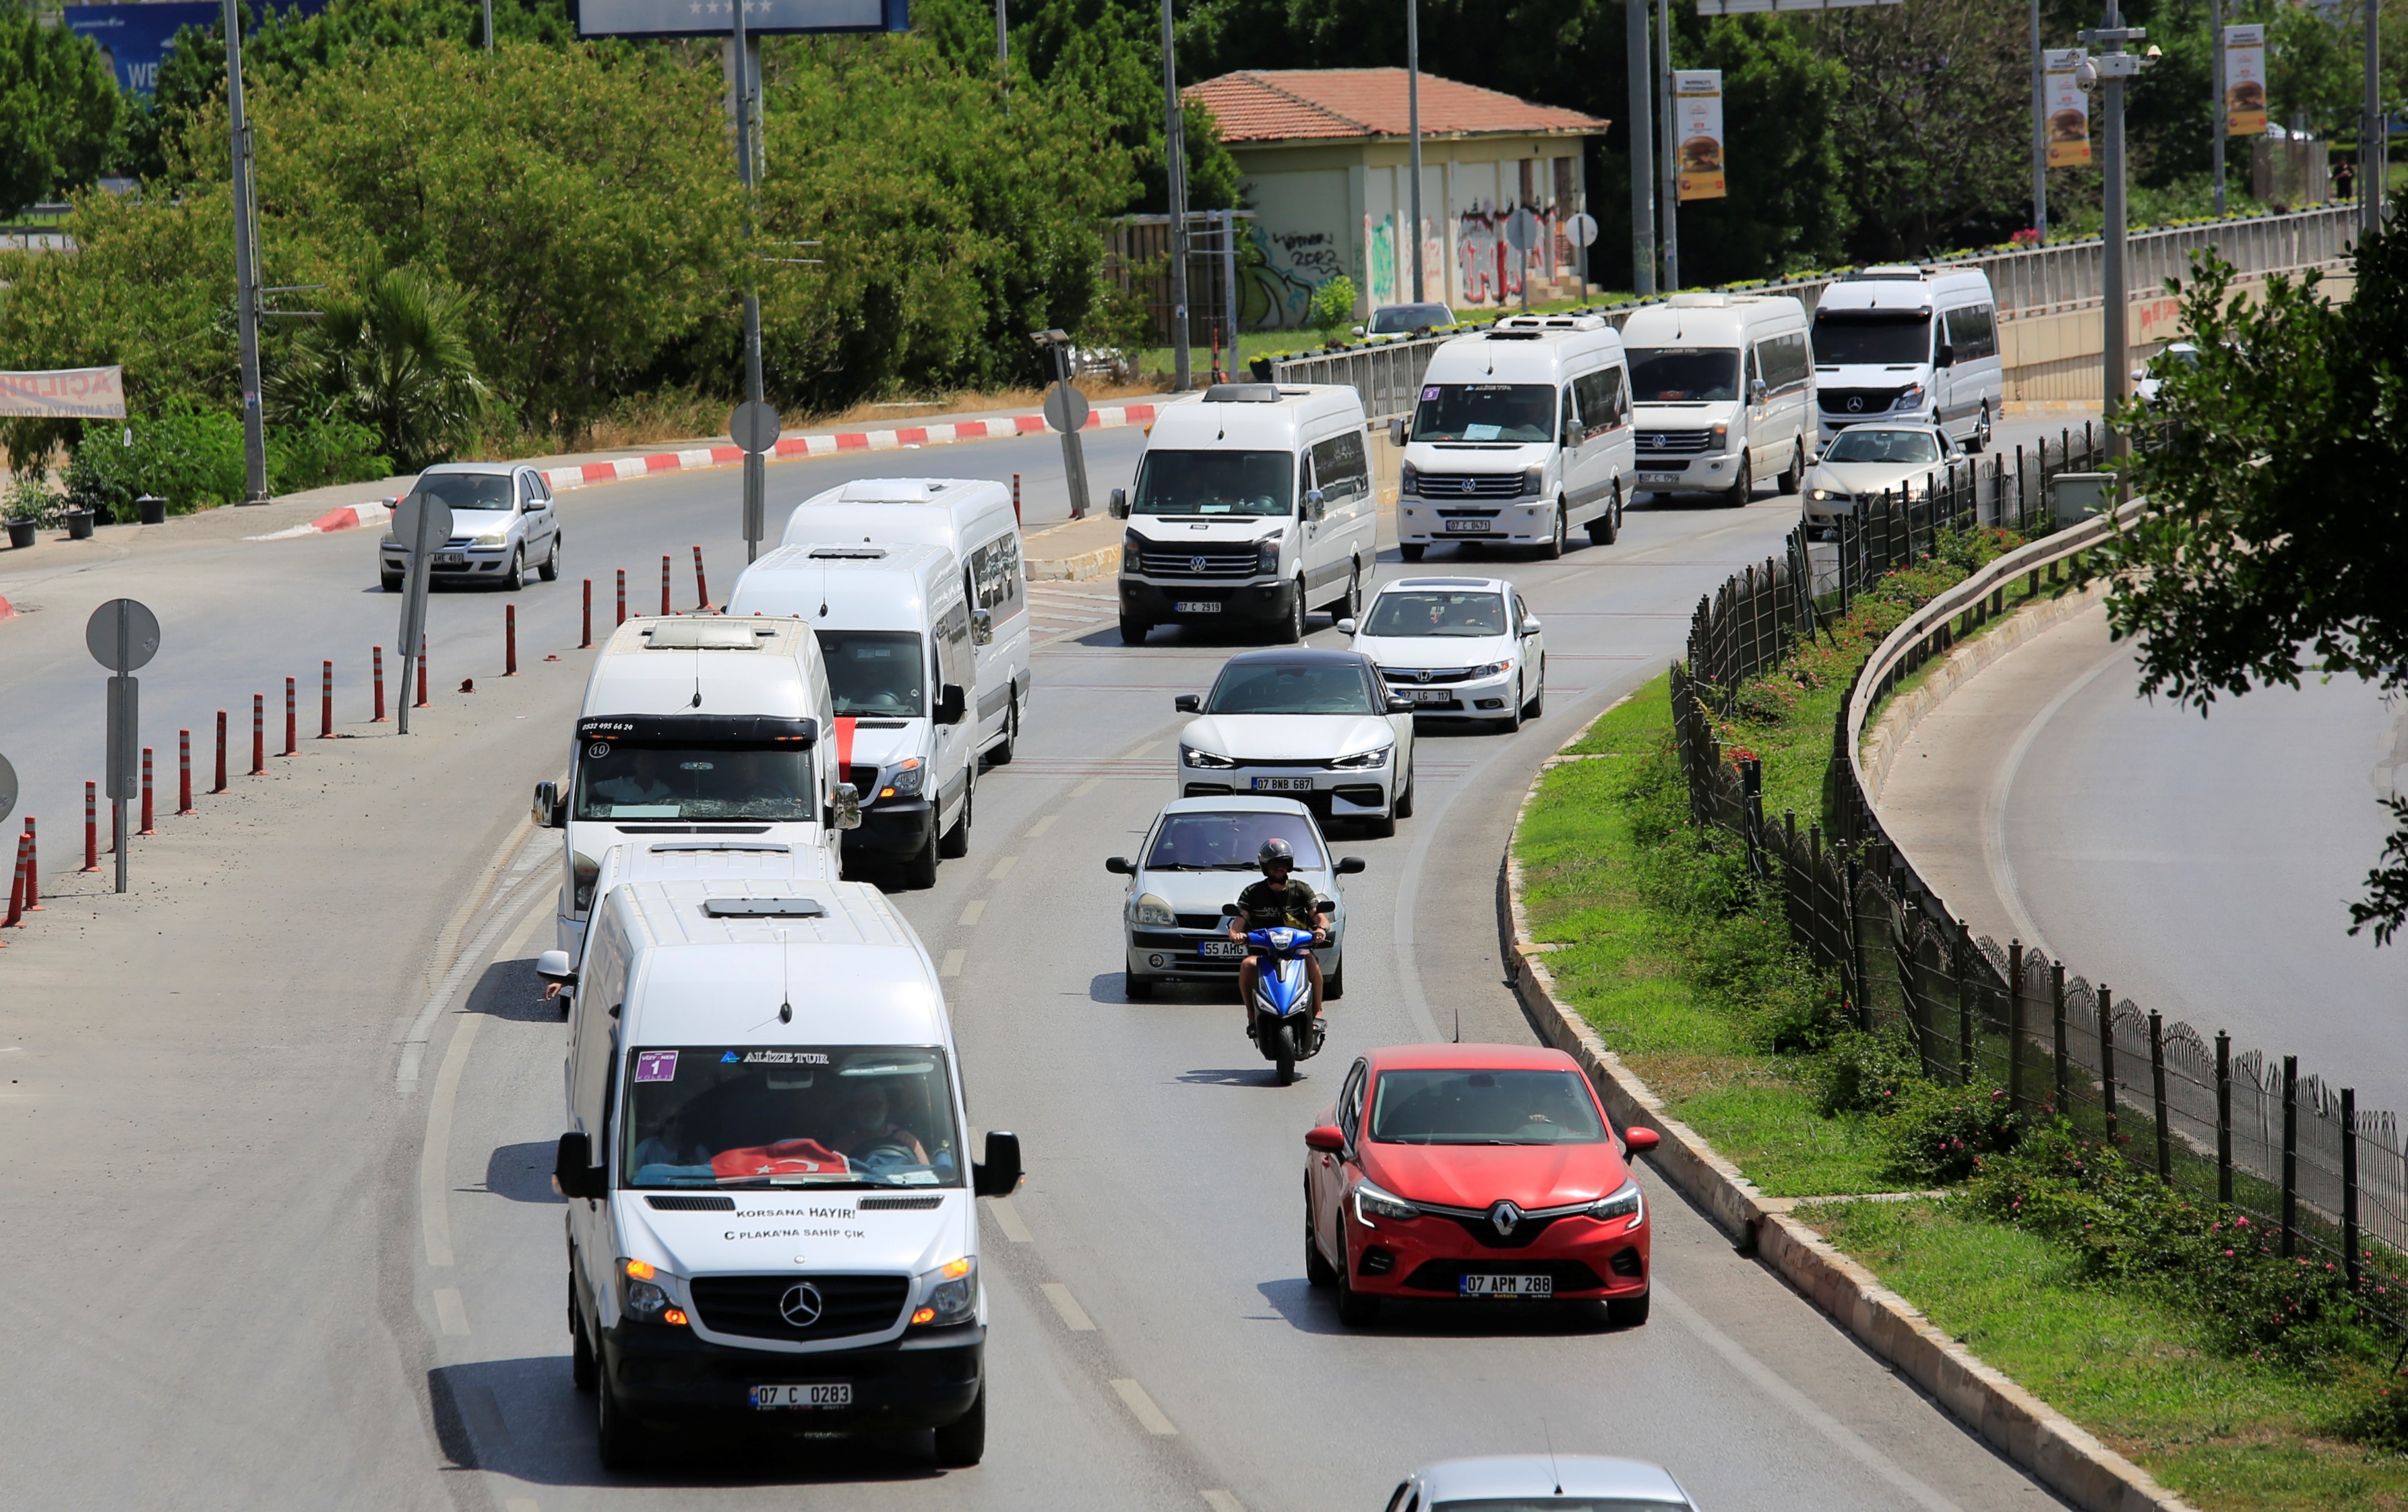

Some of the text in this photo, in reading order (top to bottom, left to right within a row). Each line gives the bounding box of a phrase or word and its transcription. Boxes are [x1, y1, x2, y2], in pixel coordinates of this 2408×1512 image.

[1179, 603, 1220, 611] 07 C 2919
[1418, 692, 1428, 700] LG
[1437, 692, 1449, 700] 117
[592, 745, 606, 755] 10
[1258, 779, 1311, 790] 07 BNB 687
[1205, 943, 1244, 954] 55 AHG
[742, 1049, 830, 1065] ALİZE TUR
[651, 1060, 660, 1076] 1
[736, 1207, 856, 1220] KORSANA HAYIR!
[724, 1230, 735, 1240] C
[803, 1228, 840, 1237] SAHİP
[844, 1230, 866, 1239] ÇIK
[1467, 1276, 1551, 1292] 07 APM 288
[759, 1386, 848, 1404] 07 C 0283
